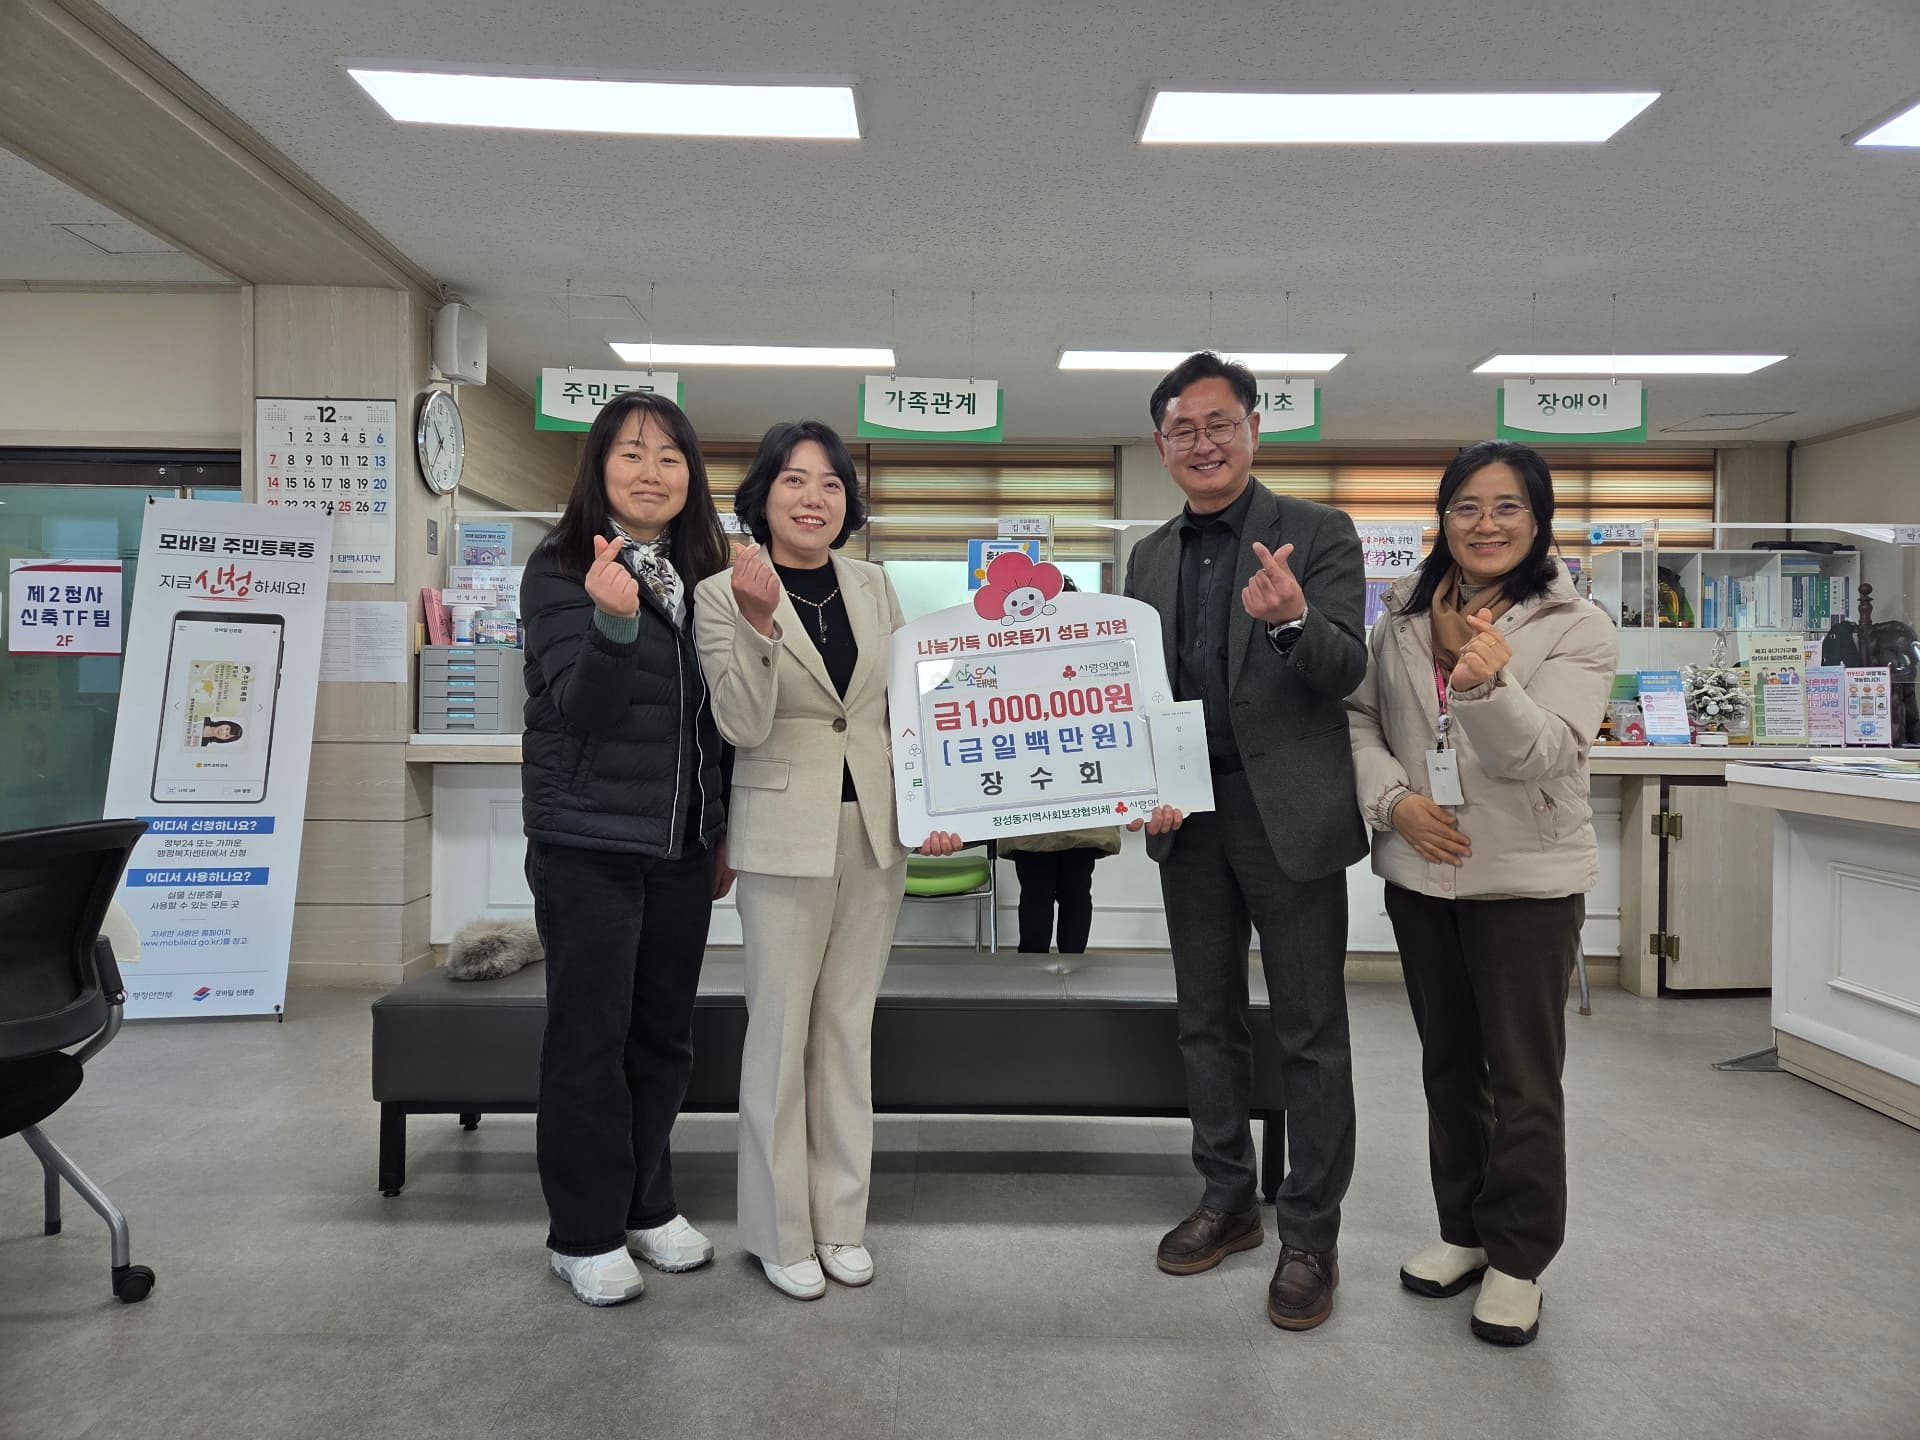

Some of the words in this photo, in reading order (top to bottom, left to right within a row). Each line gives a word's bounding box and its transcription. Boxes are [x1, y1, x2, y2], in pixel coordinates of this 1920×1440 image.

[885, 390, 976, 415] 가족관계
[317, 406, 337, 423] 12
[288, 432, 293, 443] 1
[305, 432, 313, 443] 2
[323, 432, 330, 443] 3
[341, 433, 349, 443] 4
[359, 433, 367, 444] 5
[376, 433, 384, 444] 6
[269, 454, 277, 465] 7
[288, 455, 295, 465] 8
[305, 455, 313, 465] 9
[320, 455, 333, 466] 10
[340, 456, 349, 466] 11
[357, 456, 369, 466] 12
[374, 456, 386, 467] 13
[267, 477, 279, 488] 14
[285, 478, 297, 489] 15
[303, 478, 316, 489] 16
[321, 478, 333, 488] 17
[339, 478, 351, 489] 18
[357, 478, 369, 489] 19
[373, 479, 388, 490] 20
[338, 501, 351, 512] 25
[356, 501, 370, 512] 26
[374, 501, 387, 512] 27
[159, 534, 216, 553] 모바일
[222, 537, 315, 558] 주민등록증
[159, 574, 192, 590] 지금
[195, 564, 252, 597] 신청
[254, 580, 306, 595] 하세요!
[27, 585, 104, 604] 제2청사
[20, 608, 110, 628] 신축TF팀
[56, 634, 73, 646] 2F
[917, 634, 980, 656] 나눔가득
[987, 626, 1051, 648] 이웃돕기
[1057, 623, 1089, 641] 성금
[1096, 618, 1128, 636] 지원
[1078, 660, 1130, 674] 사랑의열매
[934, 682, 1134, 731] 금1,000,000원
[1128, 799, 1160, 810] 사랑의
[992, 804, 1111, 827] 장성동지역사회보장협의체
[152, 820, 188, 831] 어디서
[191, 820, 258, 831] 신청하나요?
[164, 839, 194, 847] 정부24
[196, 839, 214, 847] 또는
[215, 838, 242, 847] 가까운
[229, 849, 247, 857] 신청
[145, 872, 182, 883] 어디서
[184, 871, 252, 883] 사용하나요?
[187, 890, 223, 899] 신분증을
[150, 901, 177, 910] 사용할
[179, 901, 188, 910] 수
[191, 901, 209, 910] 있는
[210, 901, 229, 909] 모든
[231, 900, 240, 909] 곳
[176, 929, 199, 937] 사항은
[201, 928, 232, 937] 홈페이지
[132, 991, 173, 1000] 행정안전부
[215, 989, 234, 997] 모바일
[236, 988, 255, 997] 신분증
